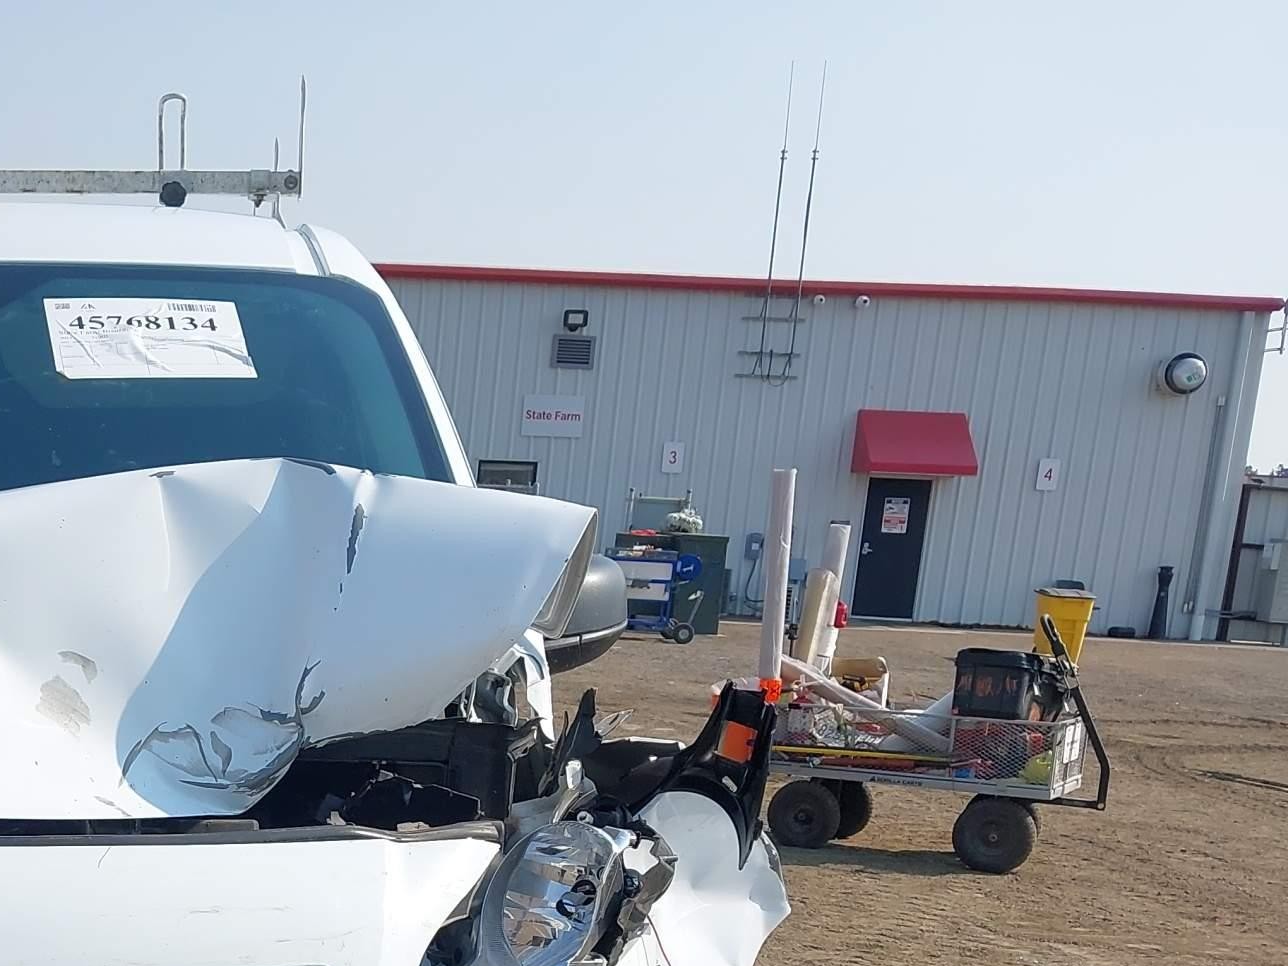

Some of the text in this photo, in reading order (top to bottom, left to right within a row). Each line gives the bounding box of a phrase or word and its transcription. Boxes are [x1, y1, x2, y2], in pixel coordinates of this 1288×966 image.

[68, 315, 218, 332] 45768134
[525, 409, 581, 422] State Farm
[668, 450, 678, 465] 3
[1043, 467, 1053, 481] 4
